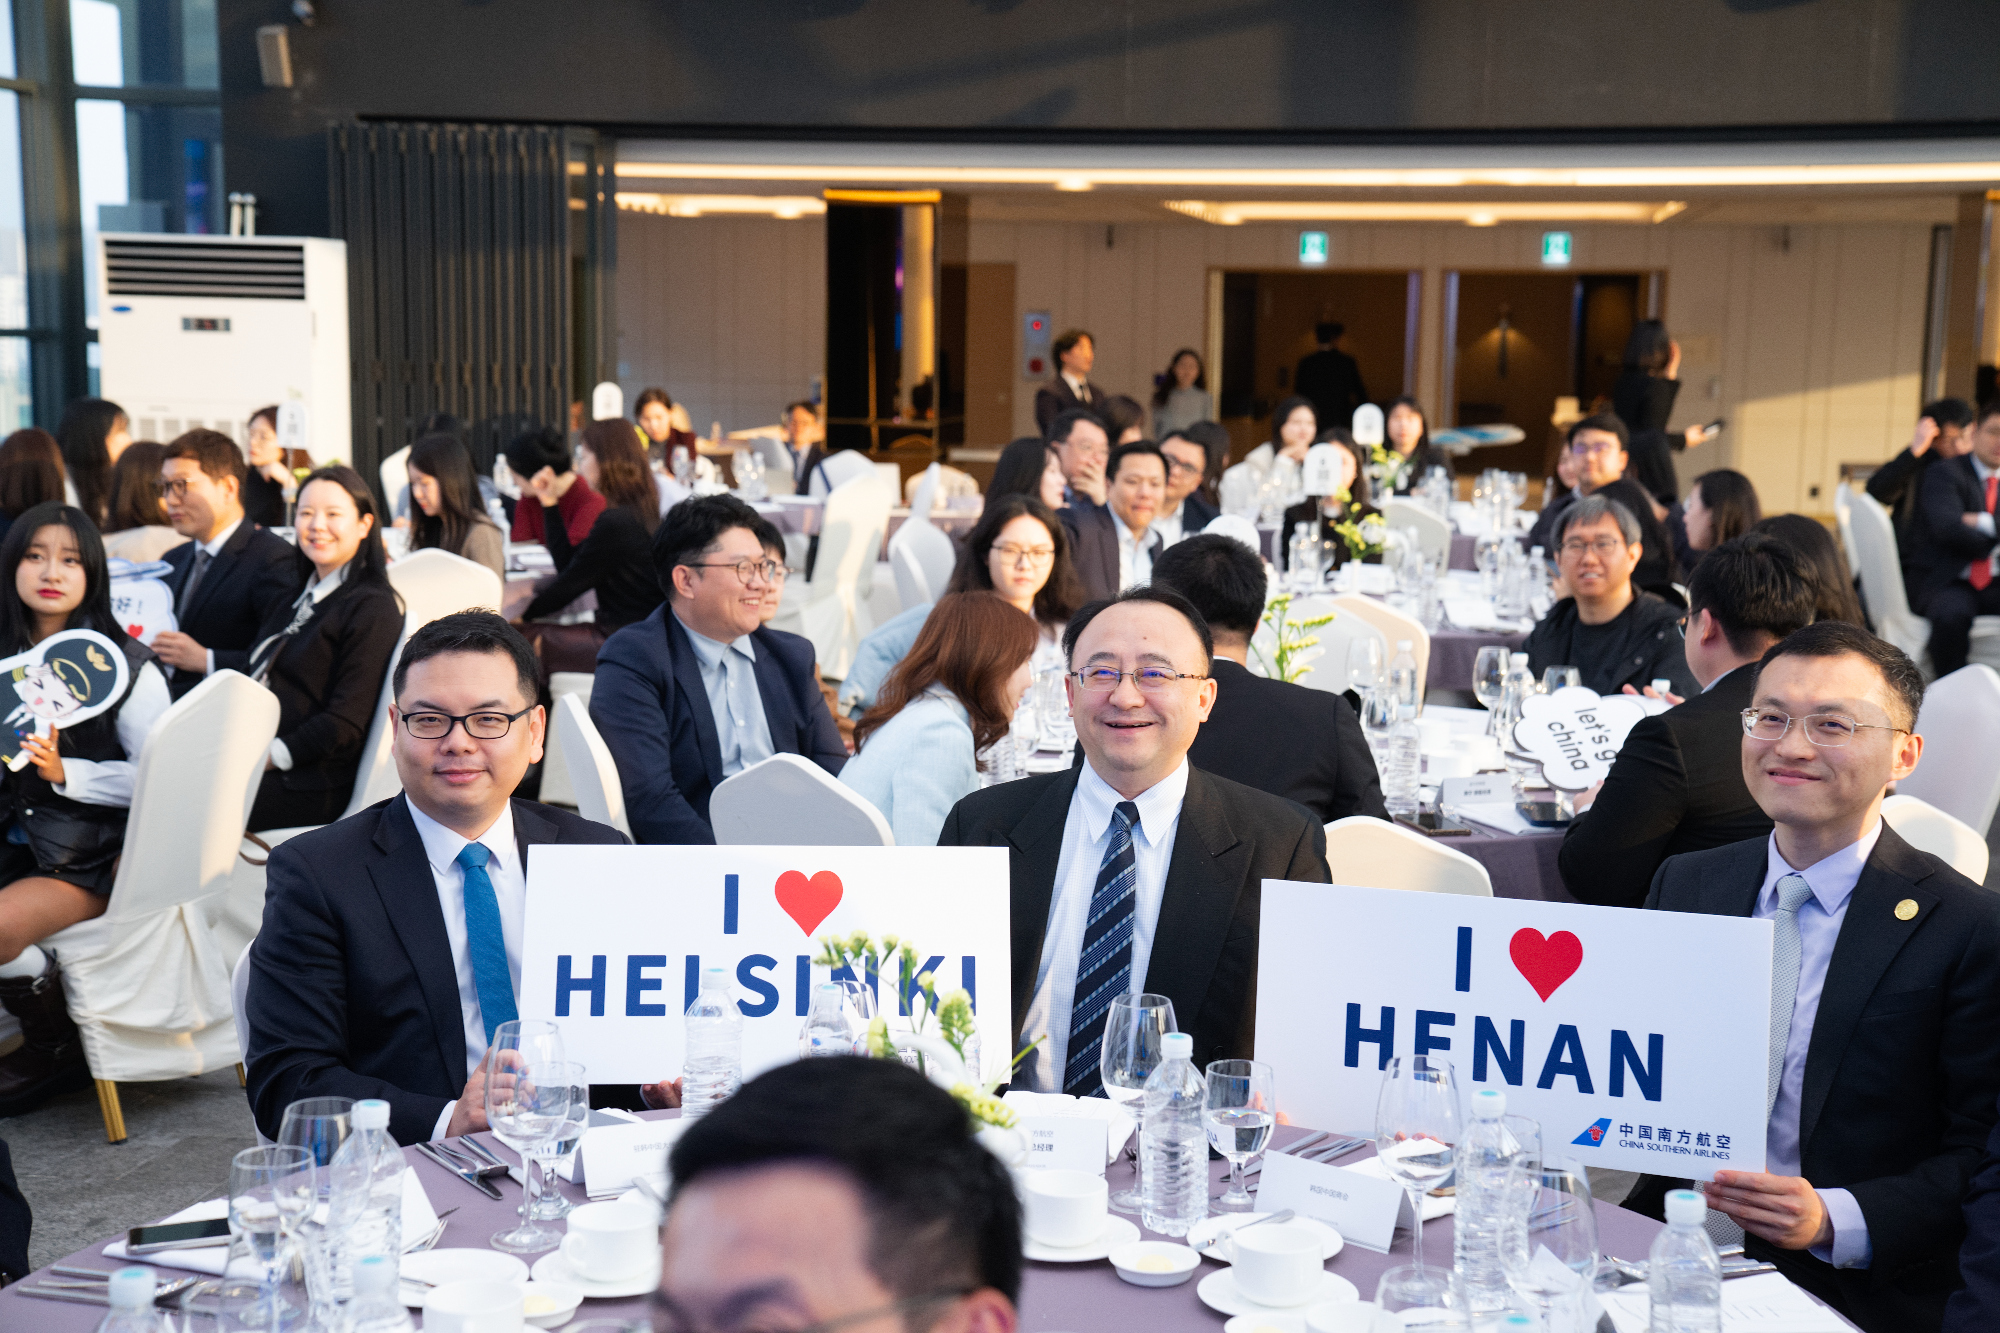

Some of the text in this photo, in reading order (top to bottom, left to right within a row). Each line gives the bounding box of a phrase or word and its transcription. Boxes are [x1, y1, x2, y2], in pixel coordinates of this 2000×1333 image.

[1547, 721, 1590, 771] china
[1574, 707, 1618, 769] let's g
[723, 873, 739, 935] I
[1455, 926, 1472, 992] I
[1344, 1002, 1664, 1102] HENAN
[1619, 1122, 1731, 1150] 中国南方航空
[1619, 1139, 1730, 1160] CHINA SOUTHERN AIRLINES
